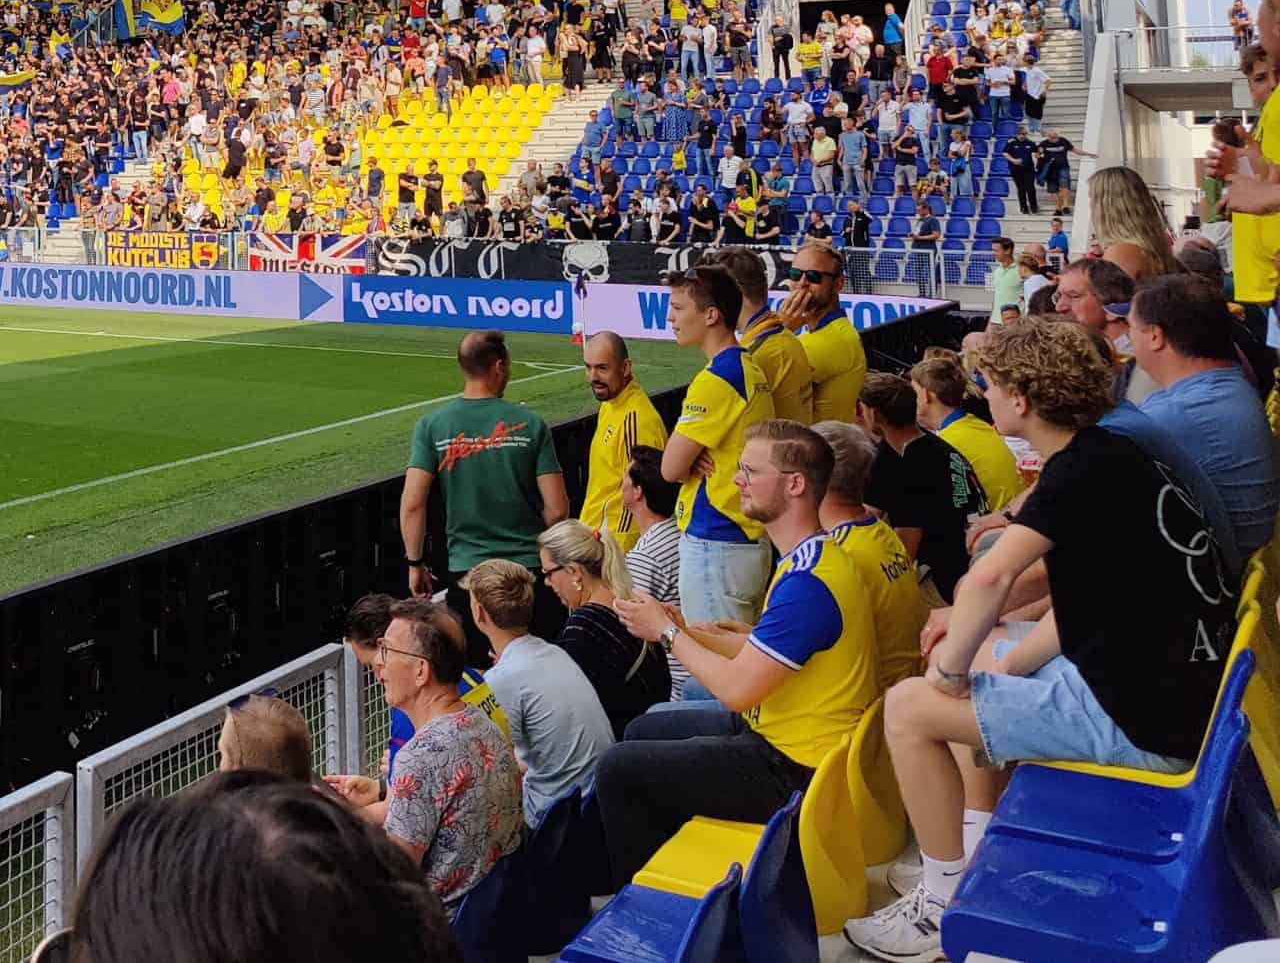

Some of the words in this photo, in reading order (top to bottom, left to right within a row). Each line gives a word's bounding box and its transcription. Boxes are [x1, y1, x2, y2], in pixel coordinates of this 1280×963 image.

[107, 231, 125, 247] DE
[129, 232, 190, 249] MOOISTE
[107, 247, 191, 269] KUTCLUB
[351, 282, 457, 320] koston
[467, 289, 565, 320] noord
